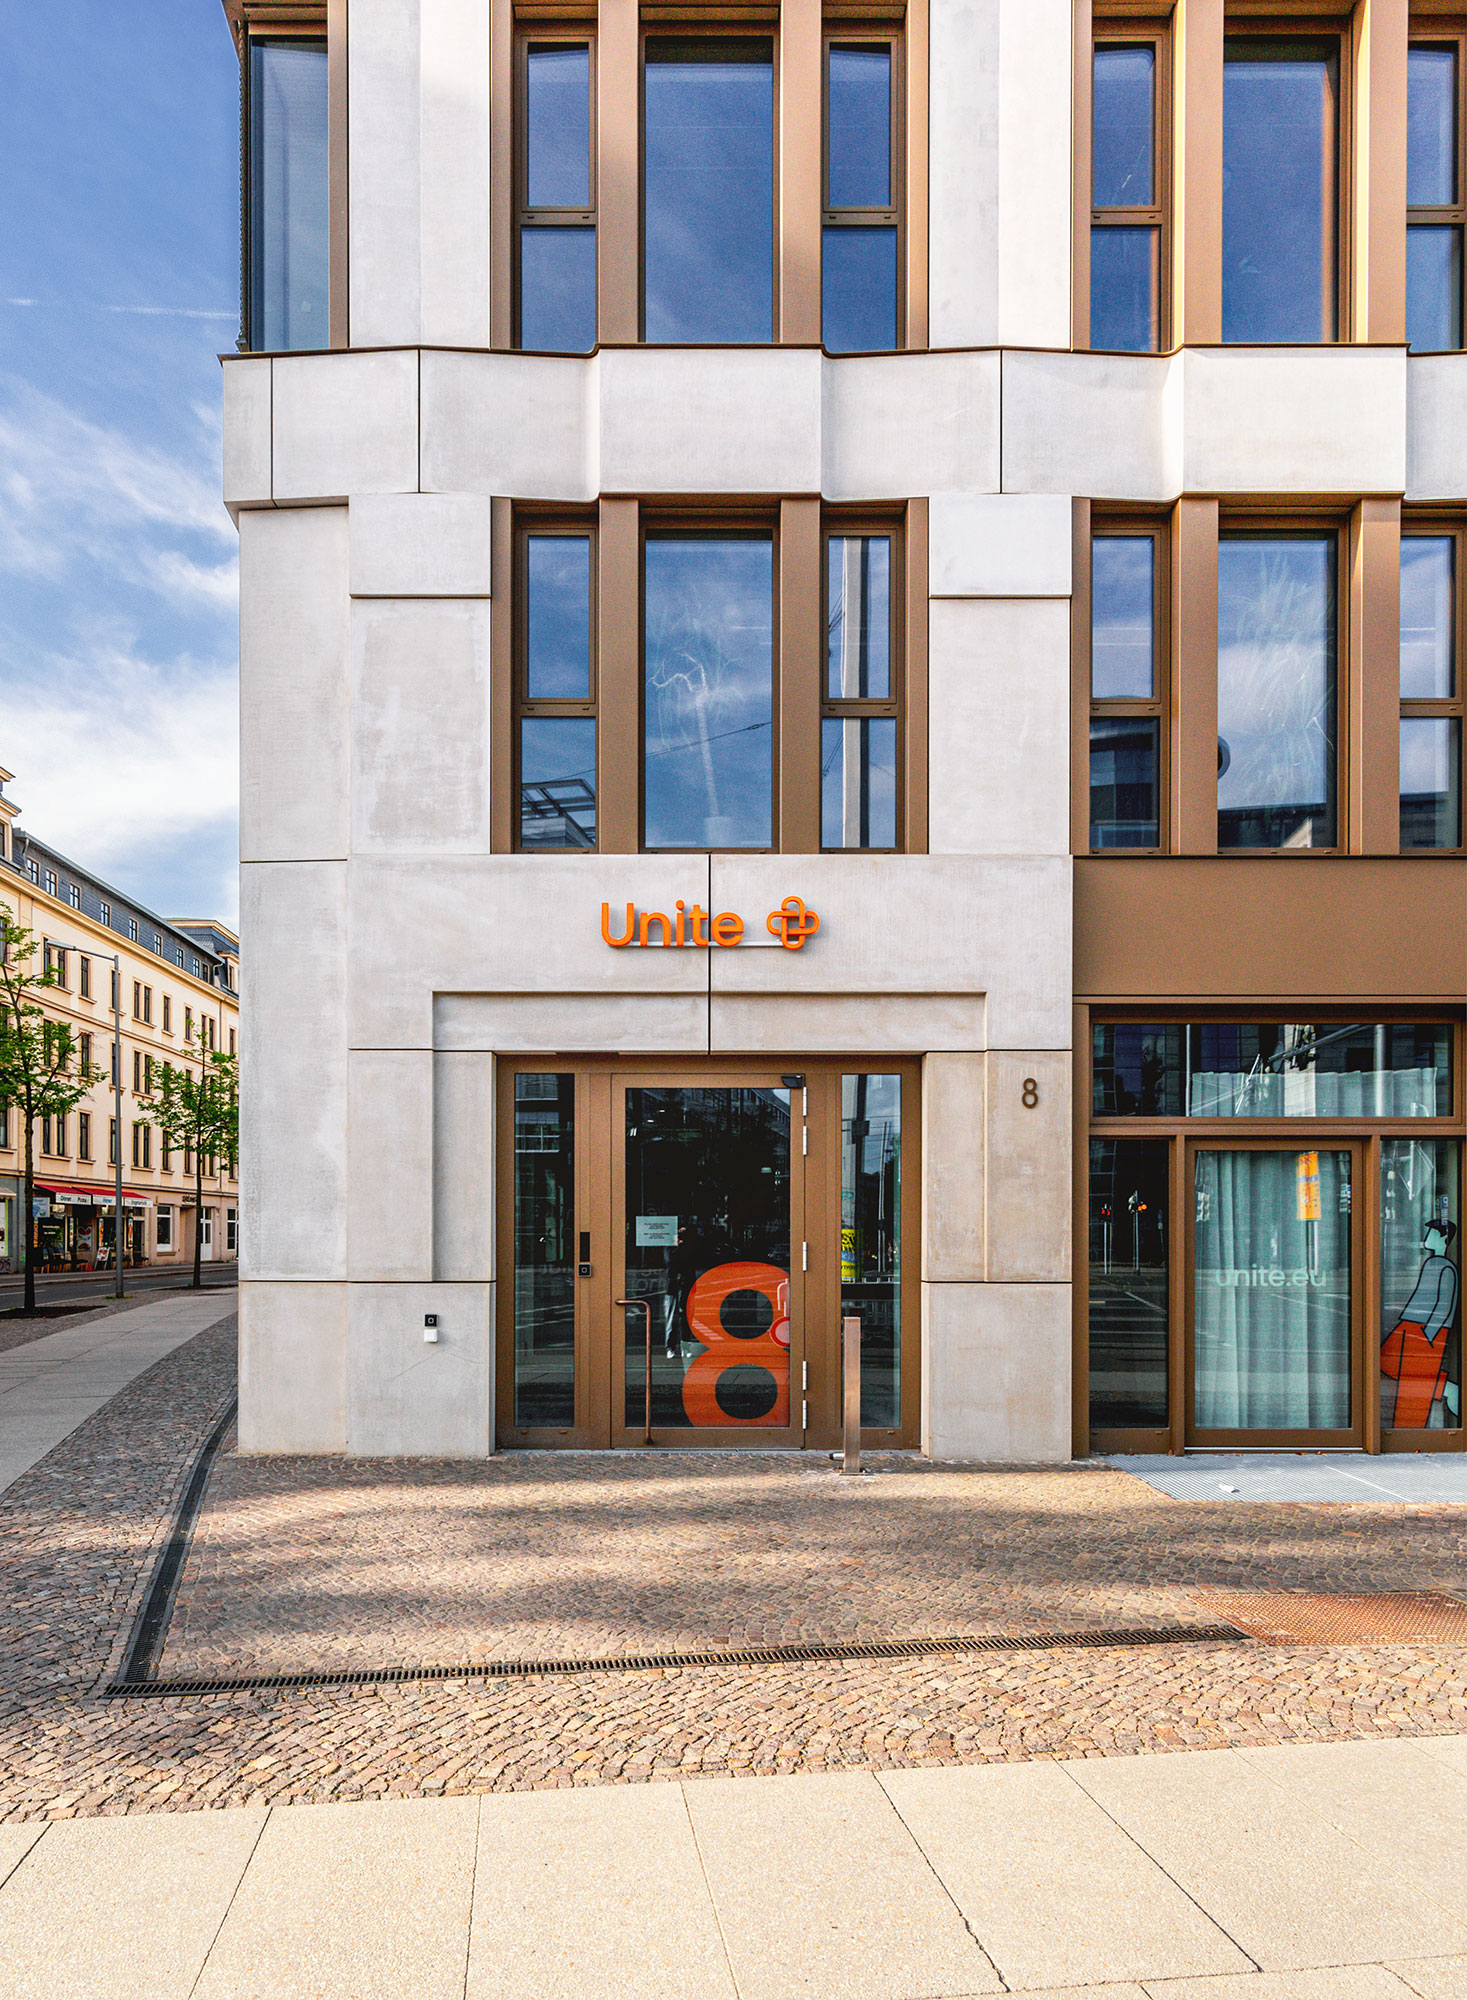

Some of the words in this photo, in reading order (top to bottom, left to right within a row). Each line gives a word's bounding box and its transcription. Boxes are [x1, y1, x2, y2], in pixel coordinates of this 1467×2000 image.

[601, 899, 744, 947] Unite
[1022, 1077, 1039, 1110] 8
[1215, 1264, 1327, 1288] unite.eu
